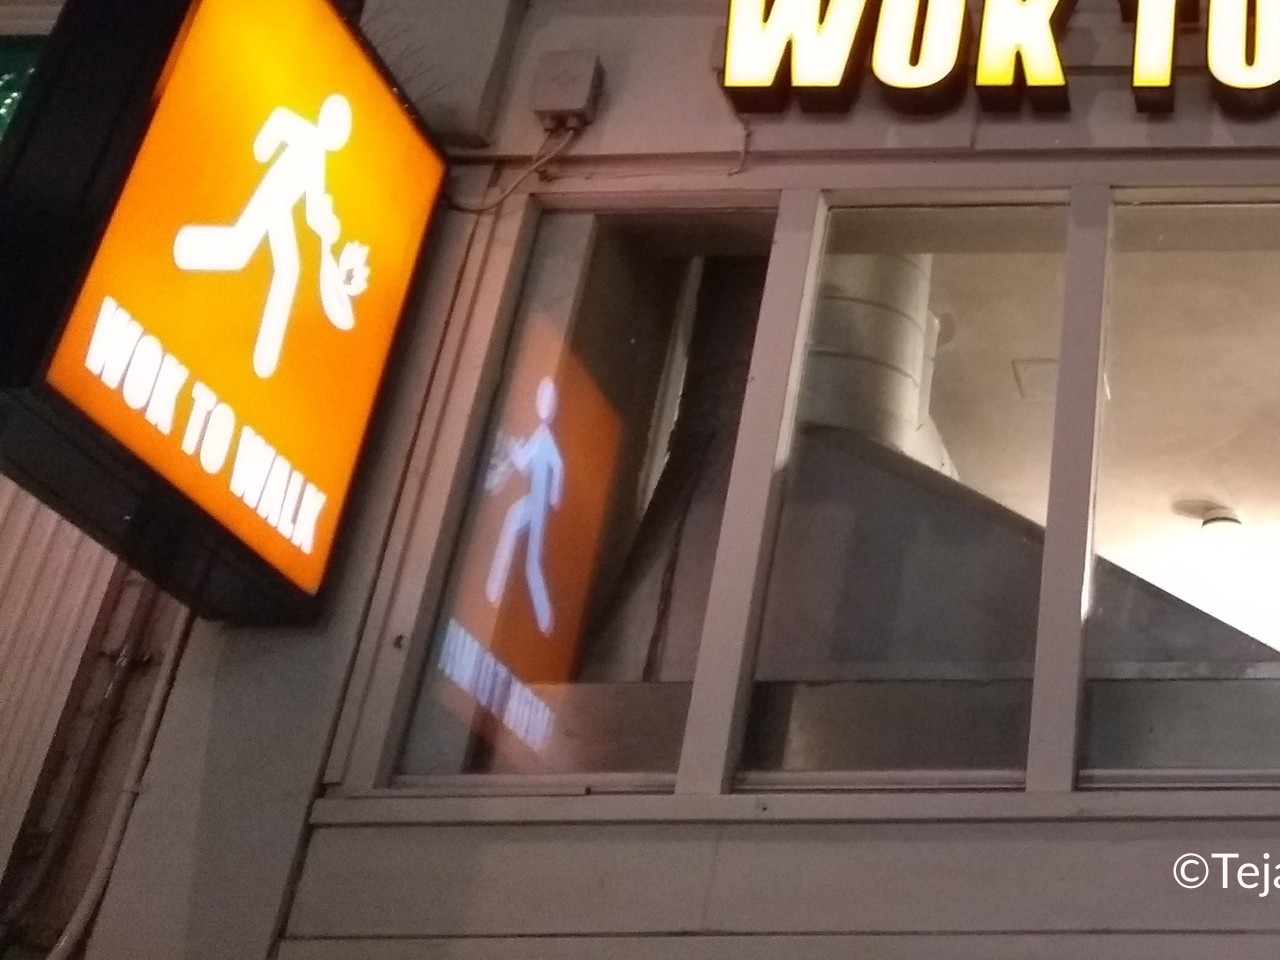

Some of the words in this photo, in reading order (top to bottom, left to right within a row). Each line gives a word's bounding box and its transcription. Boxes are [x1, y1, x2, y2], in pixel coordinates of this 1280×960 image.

[84, 294, 190, 436] WOK
[180, 380, 237, 475] TO
[229, 424, 328, 556] WALK
